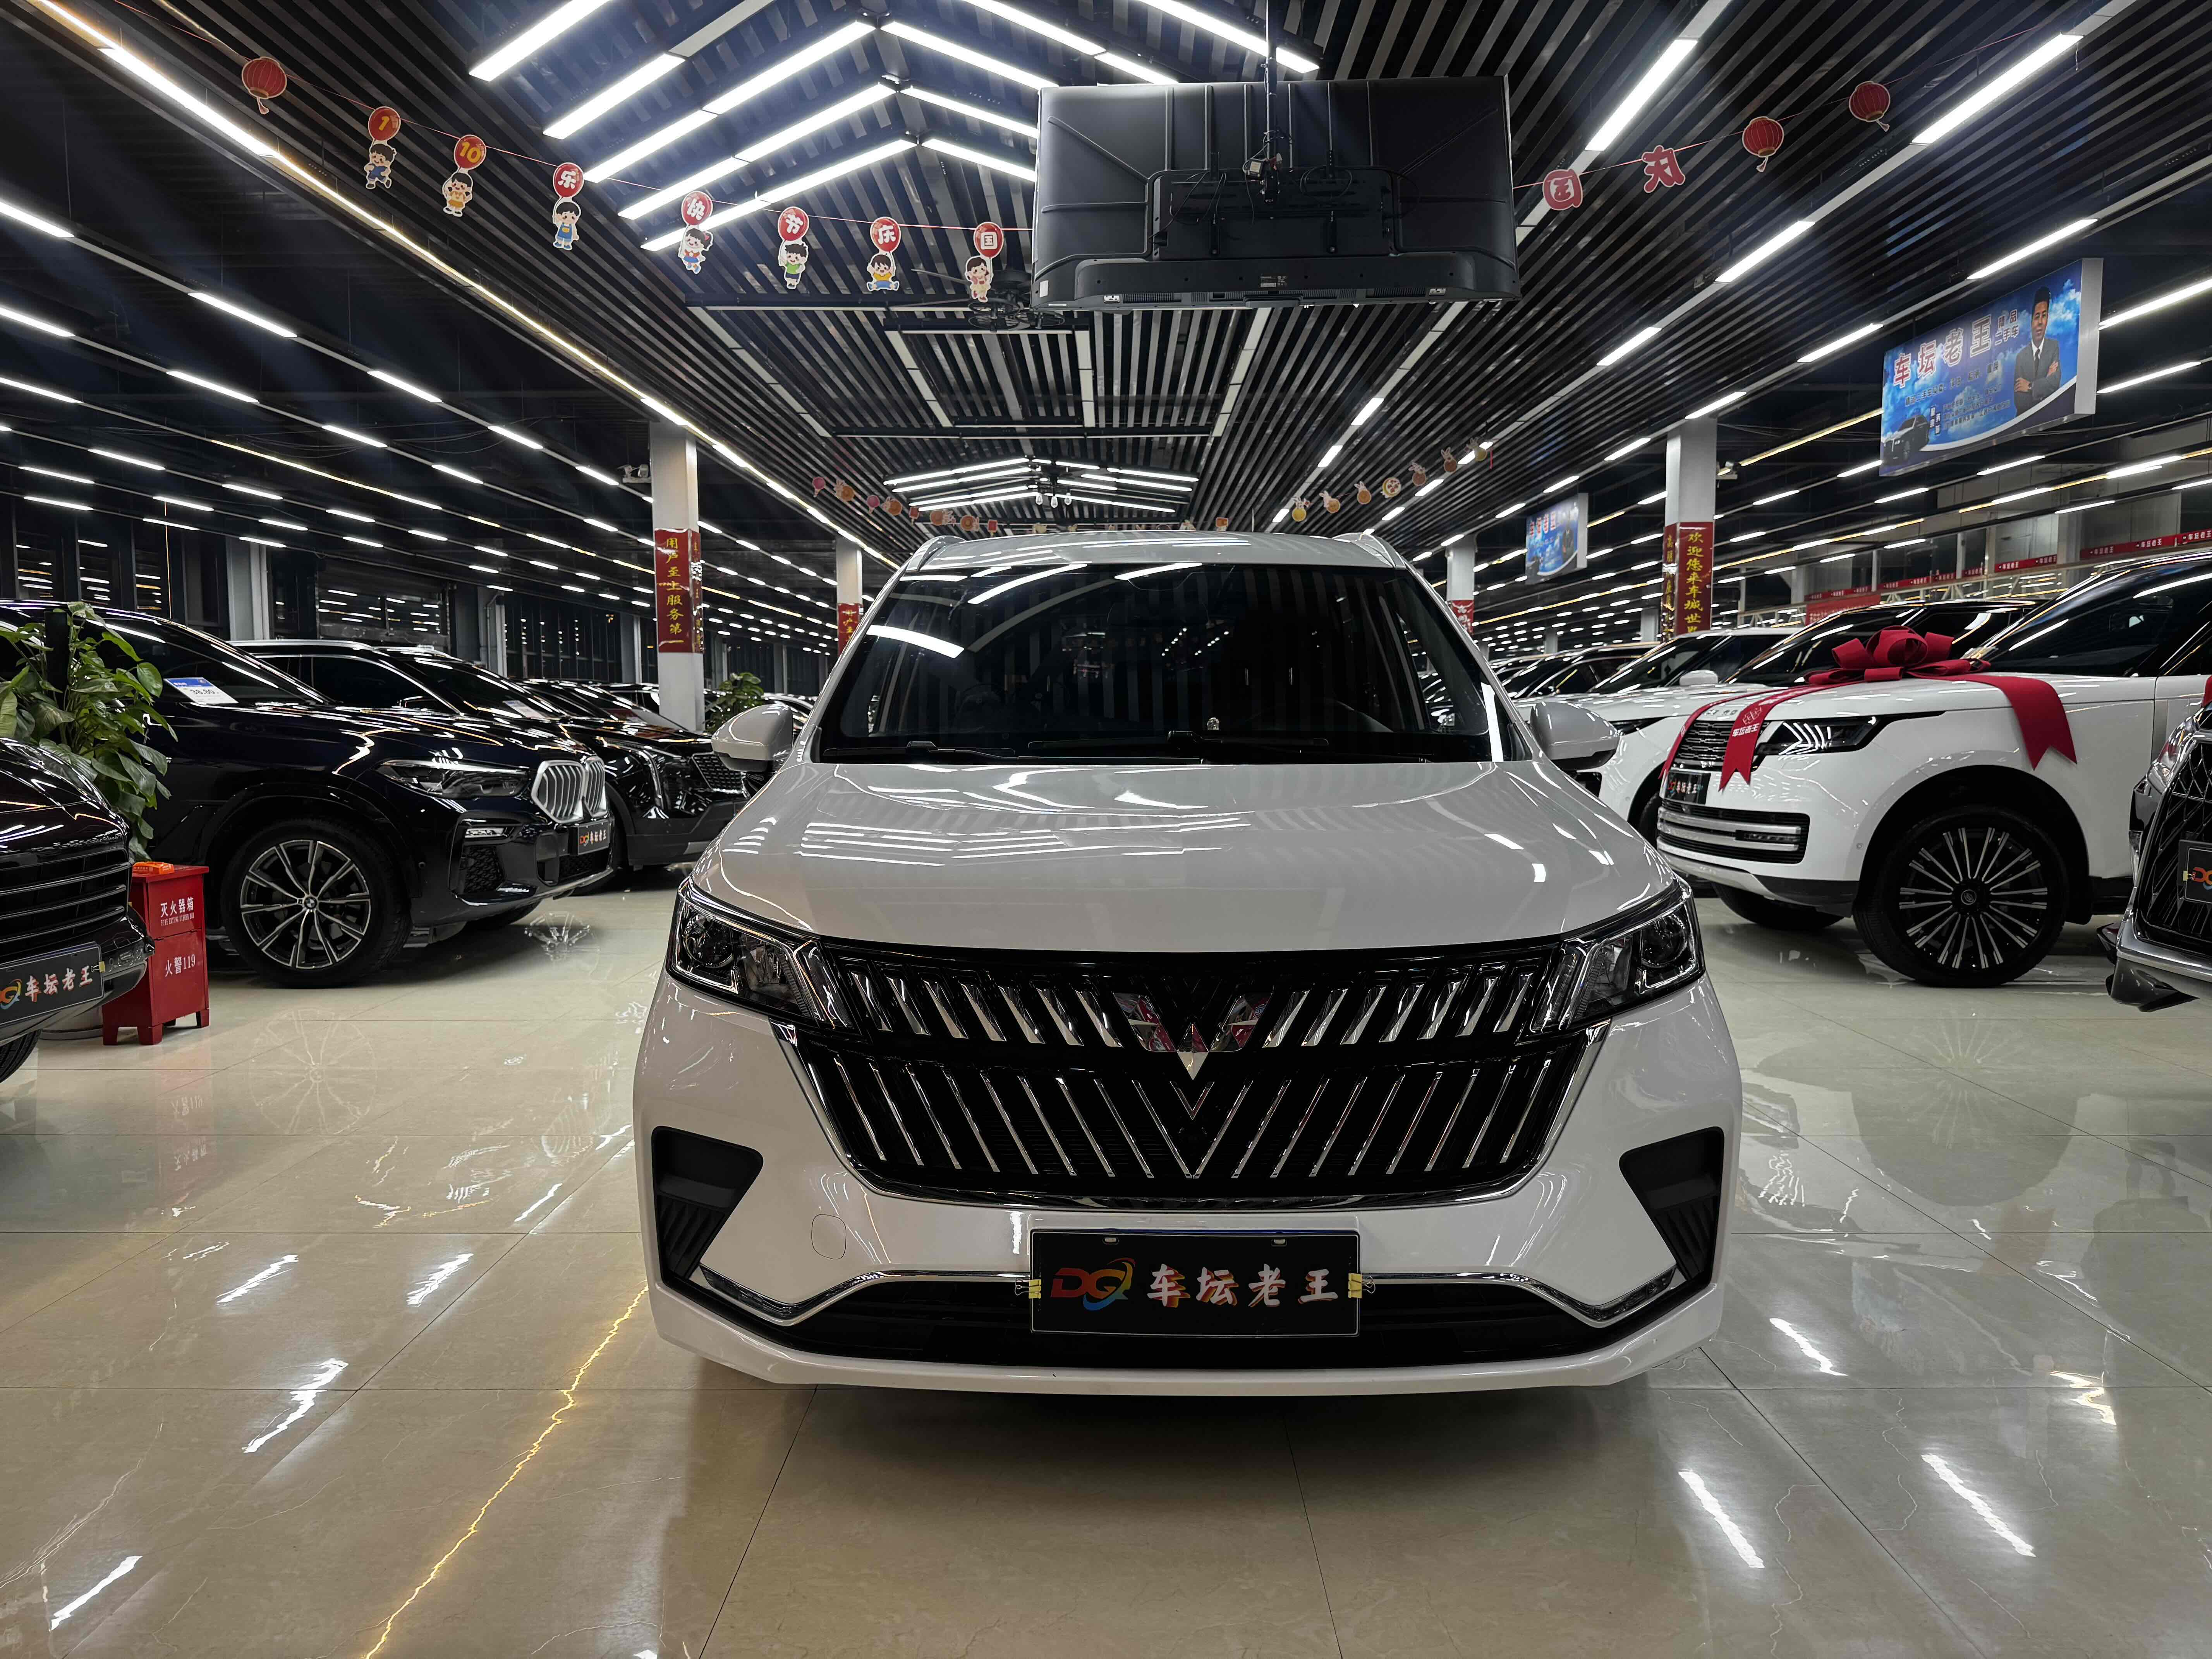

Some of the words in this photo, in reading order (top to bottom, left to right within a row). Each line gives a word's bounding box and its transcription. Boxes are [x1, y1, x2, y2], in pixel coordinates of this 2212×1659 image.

[378, 116, 389, 131] 1
[460, 142, 481, 163] 10
[558, 171, 577, 190] 乐
[687, 198, 705, 220] 快
[785, 213, 804, 234] 节
[878, 225, 896, 245] 庆
[980, 232, 998, 250] 国
[1995, 325, 2019, 346] 二手车
[1998, 309, 2017, 329] 精品
[1894, 314, 1991, 387] 车坛老王
[666, 538, 684, 643] 用户至上服务第一
[160, 896, 194, 917] 灭火器箱
[25, 965, 93, 1002] 车坛老王
[165, 954, 196, 977] 火警119
[1147, 1263, 1338, 1308] 车坛老王
